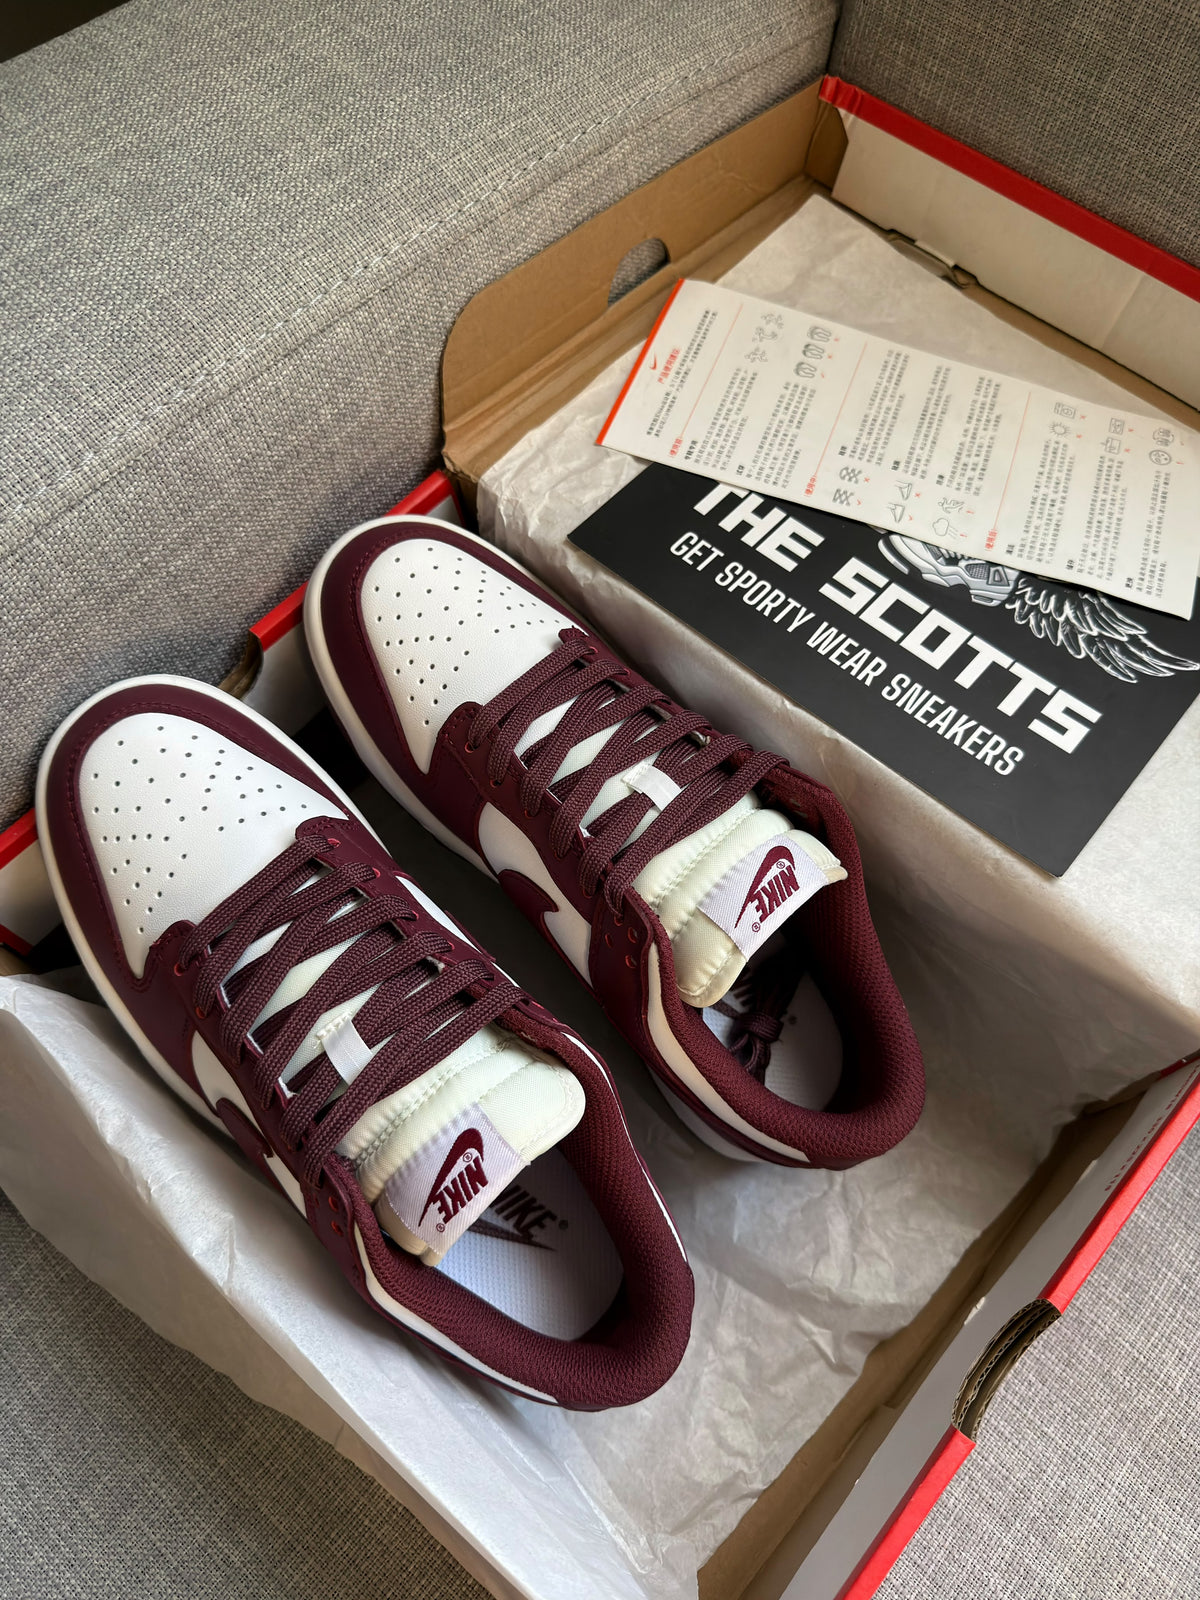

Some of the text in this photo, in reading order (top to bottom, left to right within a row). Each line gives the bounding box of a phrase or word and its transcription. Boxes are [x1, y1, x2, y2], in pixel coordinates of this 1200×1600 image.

[669, 531, 1025, 778] GET SPORTY WEAR SNEAKERS
[693, 483, 1103, 755] THE SCOTTS
[753, 865, 800, 923] NIKE
[436, 1157, 488, 1225] NIKE
